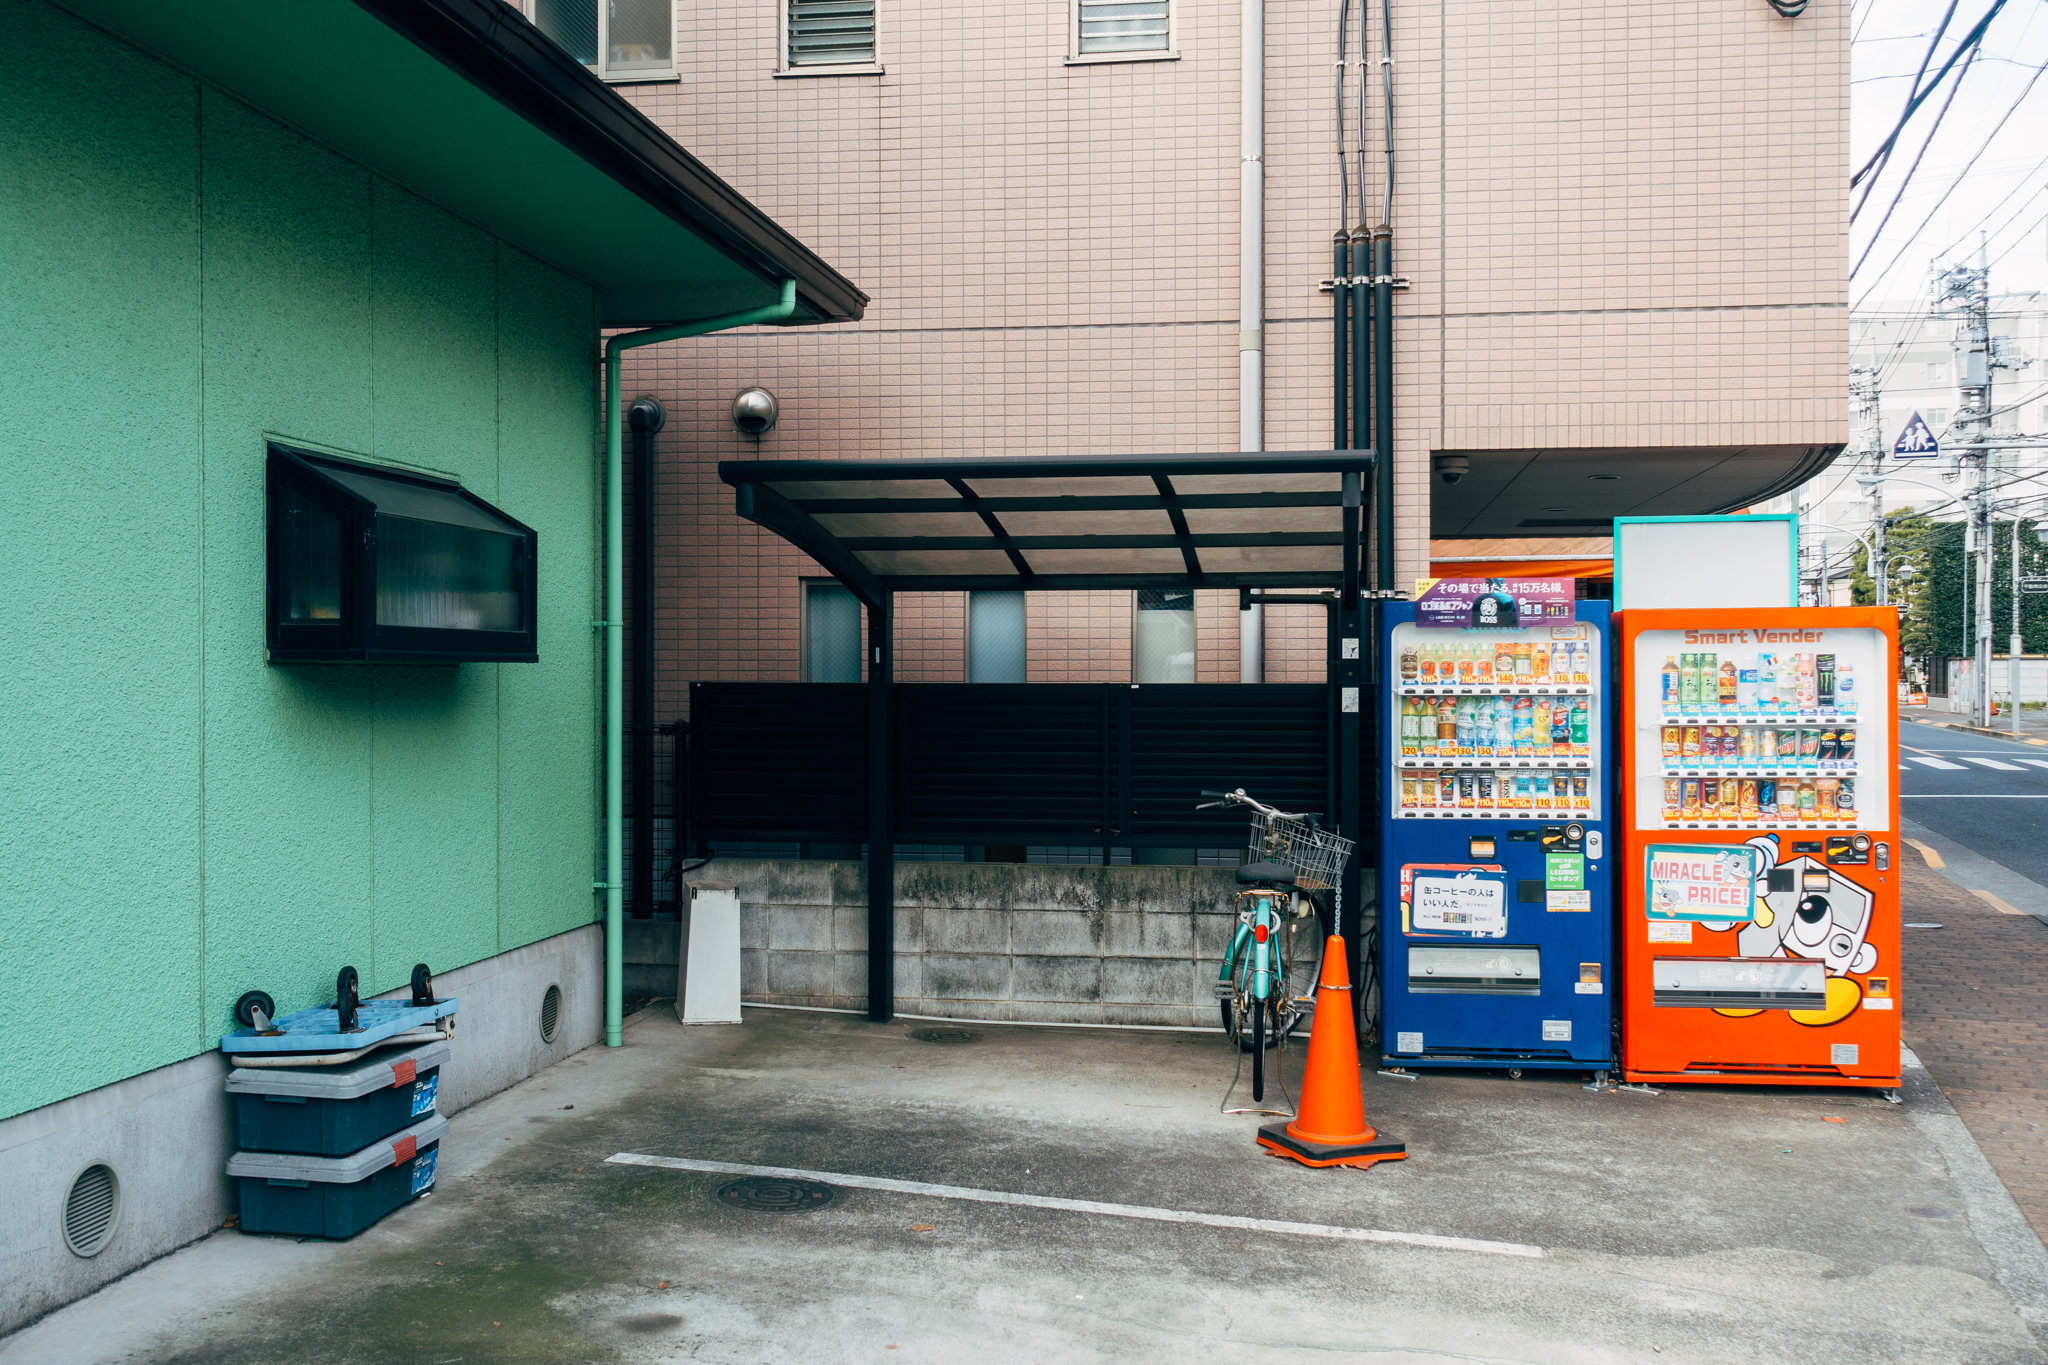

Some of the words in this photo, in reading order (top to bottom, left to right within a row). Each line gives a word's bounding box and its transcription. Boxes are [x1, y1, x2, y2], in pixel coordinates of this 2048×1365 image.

[1685, 630, 1748, 644] Smart
[1753, 629, 1823, 644] Vender
[1401, 870, 1412, 882] H
[1652, 862, 1722, 881] MIRACLE
[1401, 884, 1412, 897] P
[1424, 886, 1494, 897] 缶コーヒーの人は
[1688, 886, 1747, 905] PRICE!
[1423, 899, 1462, 908] いい人だ。
